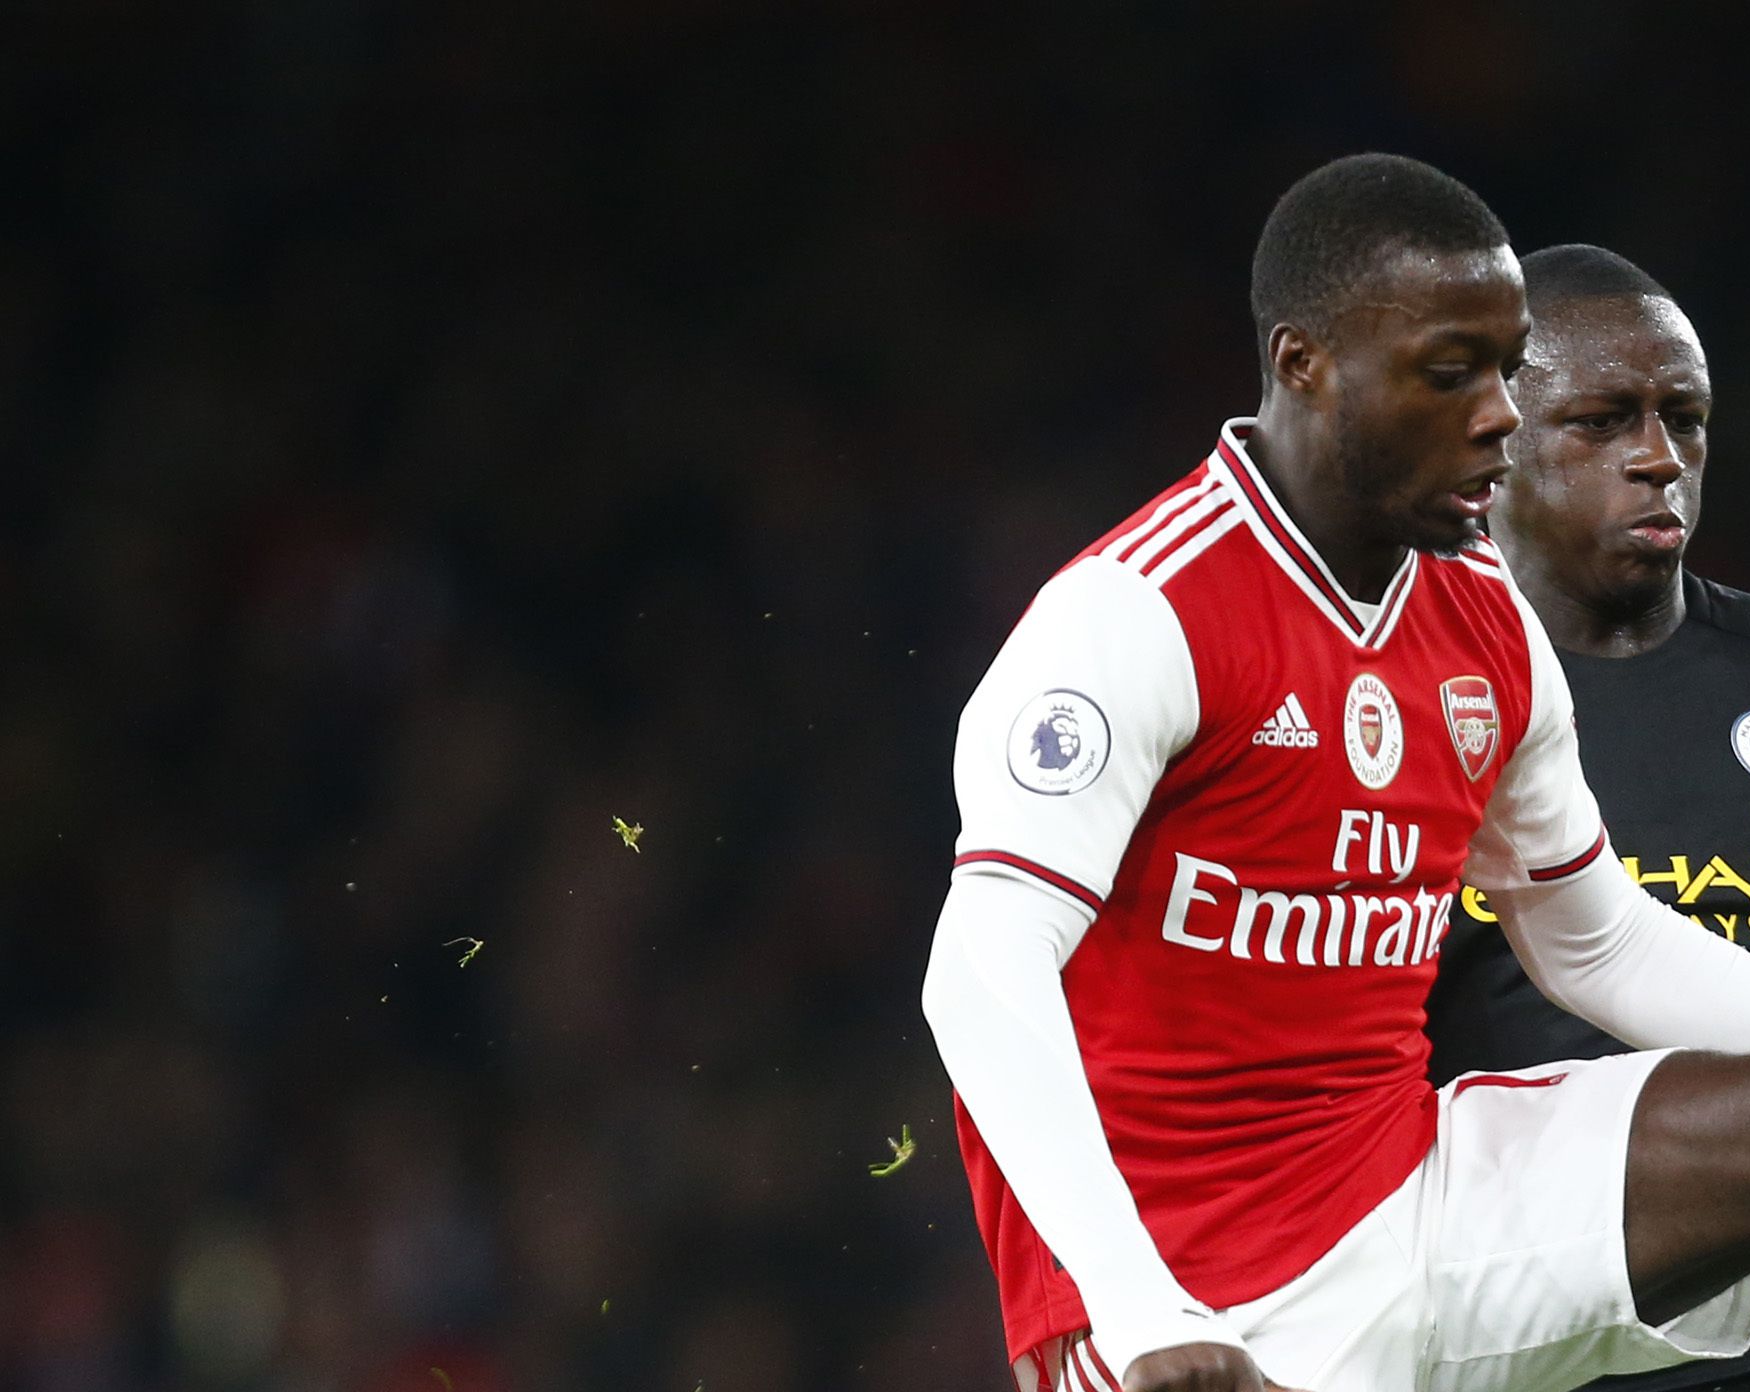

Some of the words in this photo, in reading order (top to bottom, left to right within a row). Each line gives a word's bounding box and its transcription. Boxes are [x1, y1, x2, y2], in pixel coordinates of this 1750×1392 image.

[1357, 679, 1396, 722] ARSENAL
[1451, 693, 1491, 709] Arsenal
[1252, 726, 1319, 748] adidas
[1348, 738, 1399, 783] FOUNDATION
[1332, 809, 1420, 884] Fly
[1161, 852, 1453, 967] Emirate
